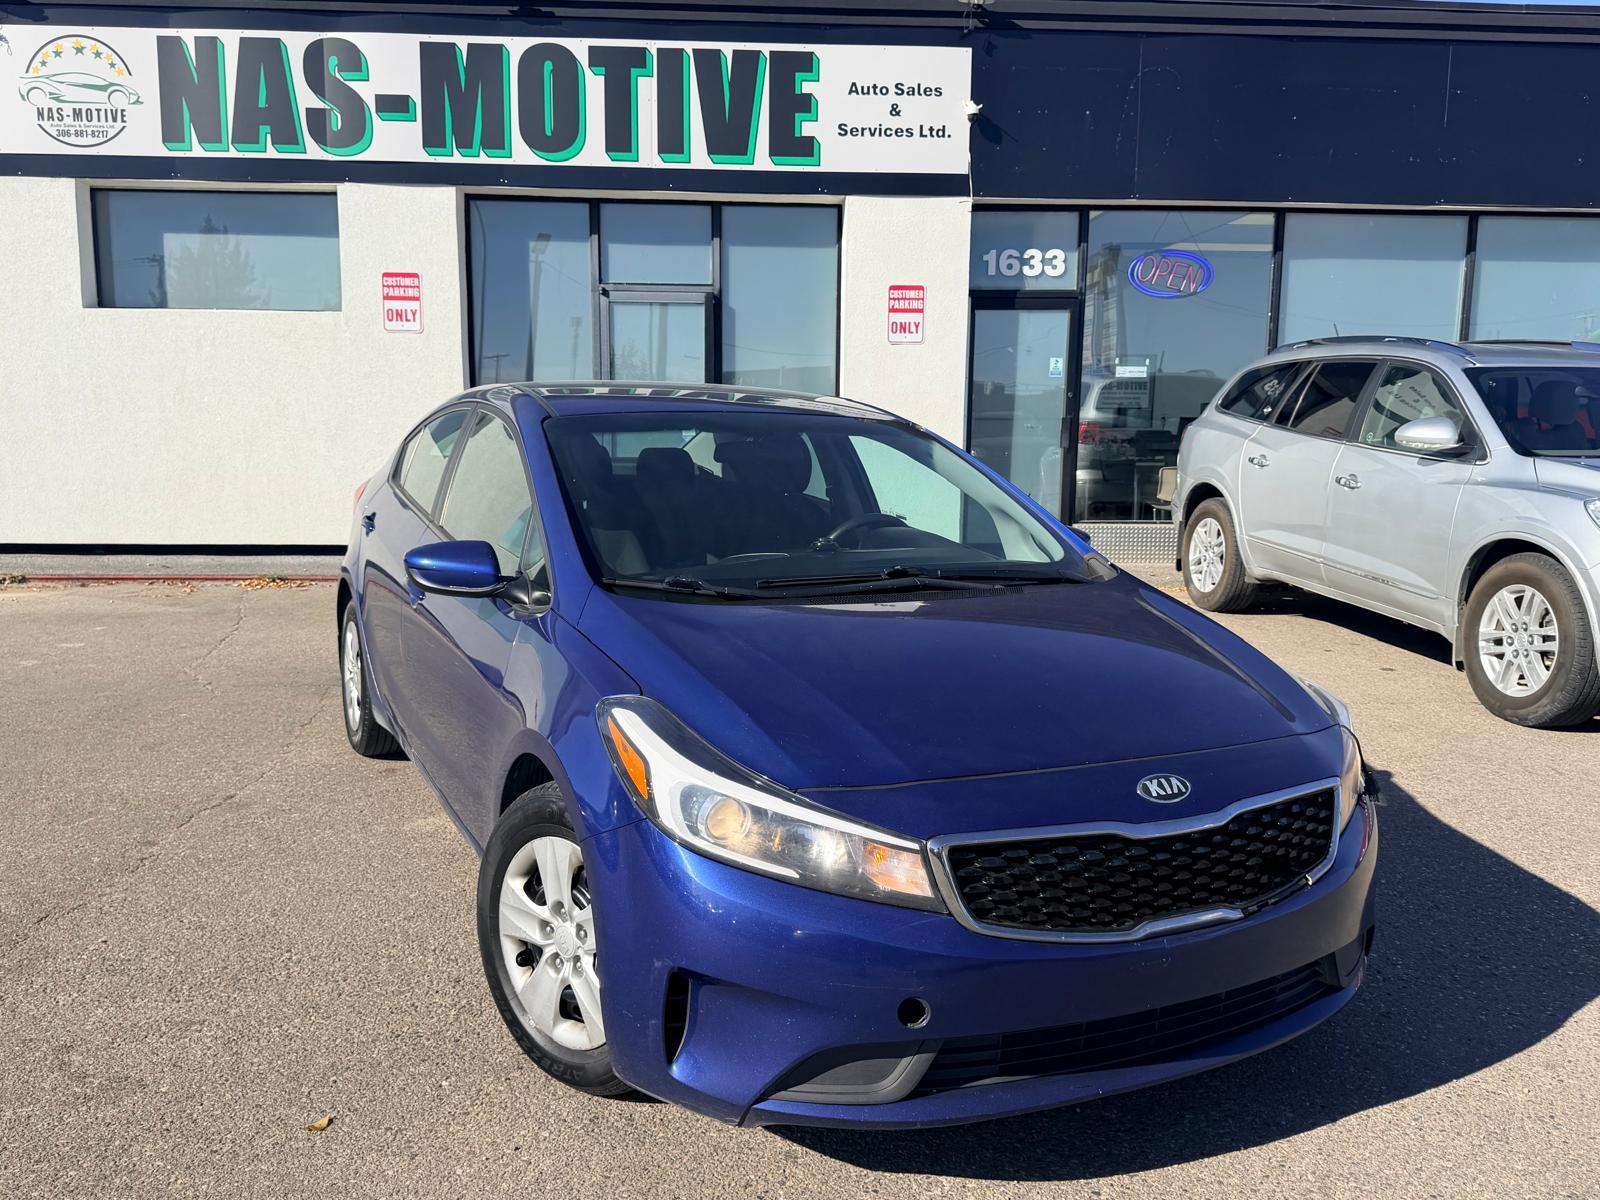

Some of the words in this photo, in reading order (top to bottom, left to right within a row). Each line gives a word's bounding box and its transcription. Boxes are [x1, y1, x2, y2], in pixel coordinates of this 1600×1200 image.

[848, 82, 889, 96] Auto
[894, 83, 943, 97] Sales
[156, 35, 820, 167] NAS-MOTIVE
[37, 107, 127, 123] NAS-MOTIVE
[889, 103, 902, 117] &
[56, 129, 108, 138] 306-881-8217
[837, 123, 914, 138] Services
[919, 124, 952, 138] Ltd.
[983, 248, 1066, 277] 1633
[1138, 255, 1200, 293] OPEN
[383, 277, 419, 286] CUSTOMER
[384, 287, 419, 297] PARKING
[889, 290, 923, 298] CUSTOMER
[889, 299, 923, 309] PARKING
[386, 308, 417, 322] ONLY
[891, 321, 920, 334] ONLY
[1143, 777, 1186, 797] KIA
